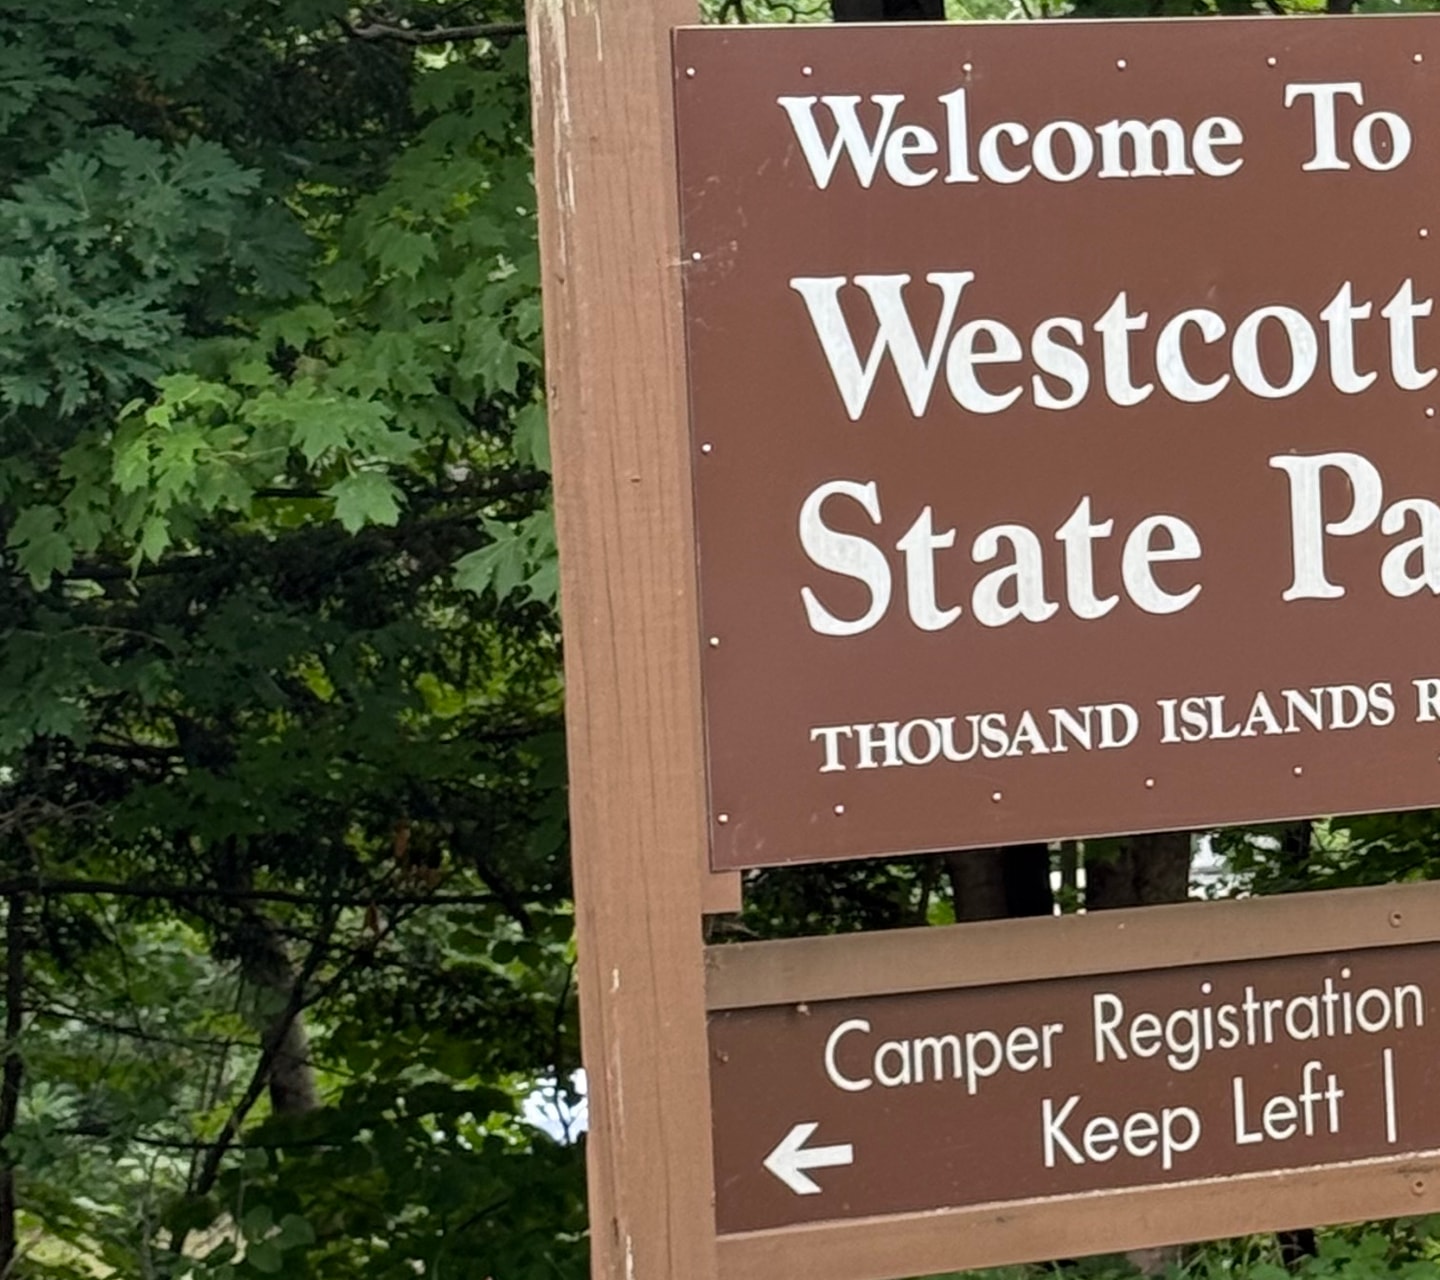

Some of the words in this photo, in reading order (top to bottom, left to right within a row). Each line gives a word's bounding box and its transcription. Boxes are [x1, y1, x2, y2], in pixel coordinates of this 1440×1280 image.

[775, 86, 1245, 191] Welcome
[1283, 80, 1413, 174] To
[788, 269, 1440, 422] Westcott
[798, 479, 1203, 637] State
[809, 702, 1140, 774] THOUSAND
[1155, 681, 1397, 745] ISLANDS
[824, 1018, 1065, 1096] Camper
[1092, 977, 1424, 1072] Registration
[1041, 1094, 1202, 1171] Keep
[1232, 1060, 1345, 1145] Left
